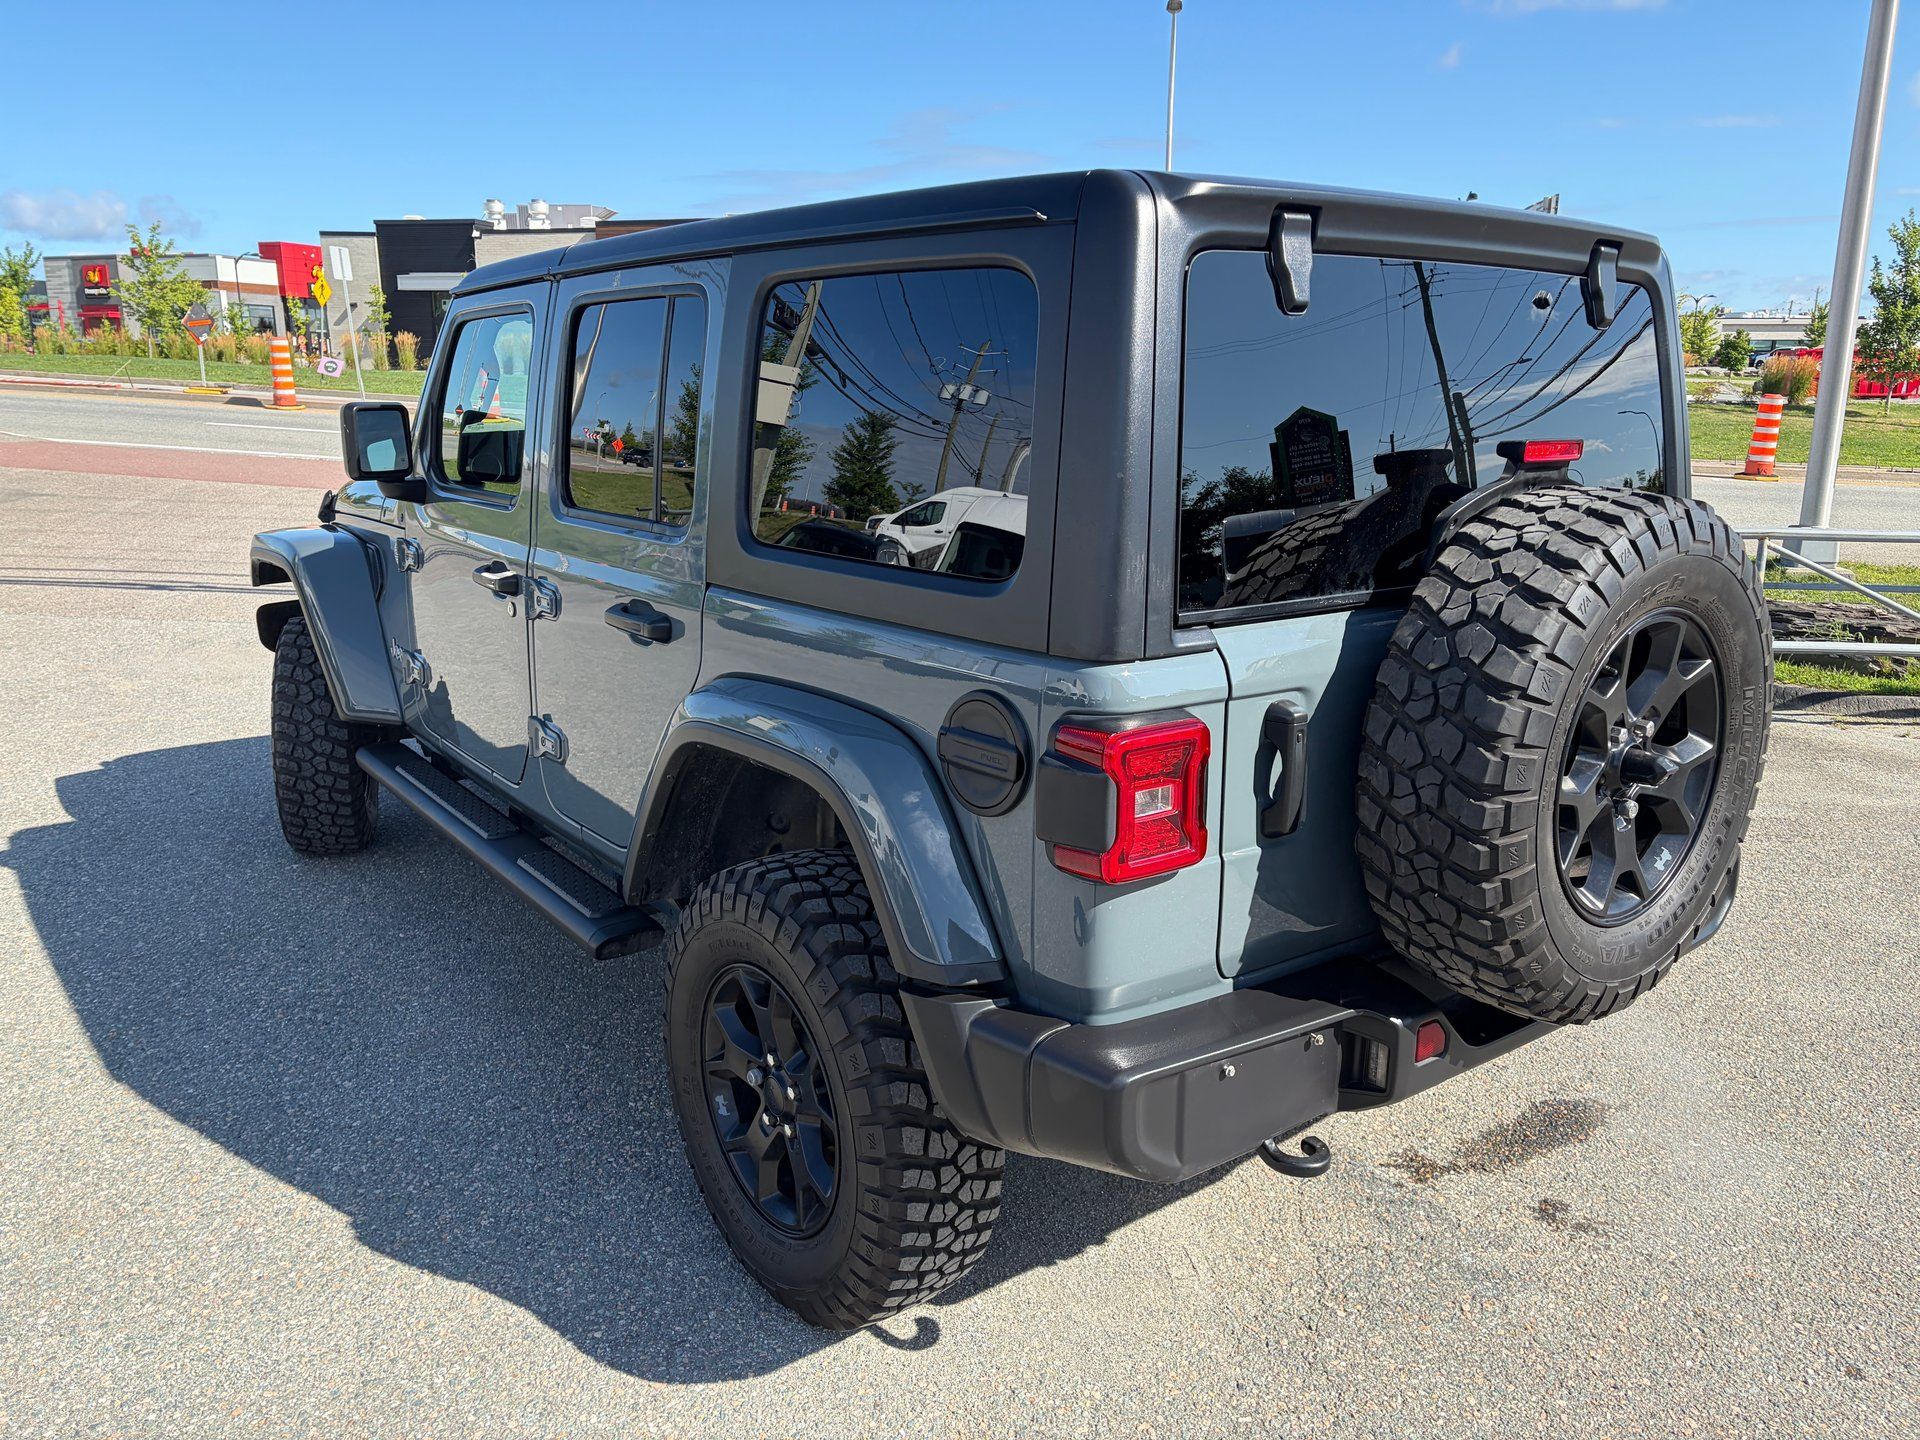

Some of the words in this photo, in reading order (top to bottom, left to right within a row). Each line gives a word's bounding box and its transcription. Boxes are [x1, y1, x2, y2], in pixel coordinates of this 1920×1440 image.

[1659, 523, 1670, 537] T/A
[1618, 546, 1632, 563] T/A
[1577, 595, 1592, 615] T/A
[980, 751, 1002, 765] FUEL
[1645, 685, 1757, 949] Mud-Terrain
[1509, 845, 1518, 866] T/A
[782, 926, 793, 941] T/A
[1599, 942, 1641, 966] T/A
[817, 977, 828, 995] T/A
[848, 1053, 859, 1072] T/A
[865, 1131, 877, 1150] T/A
